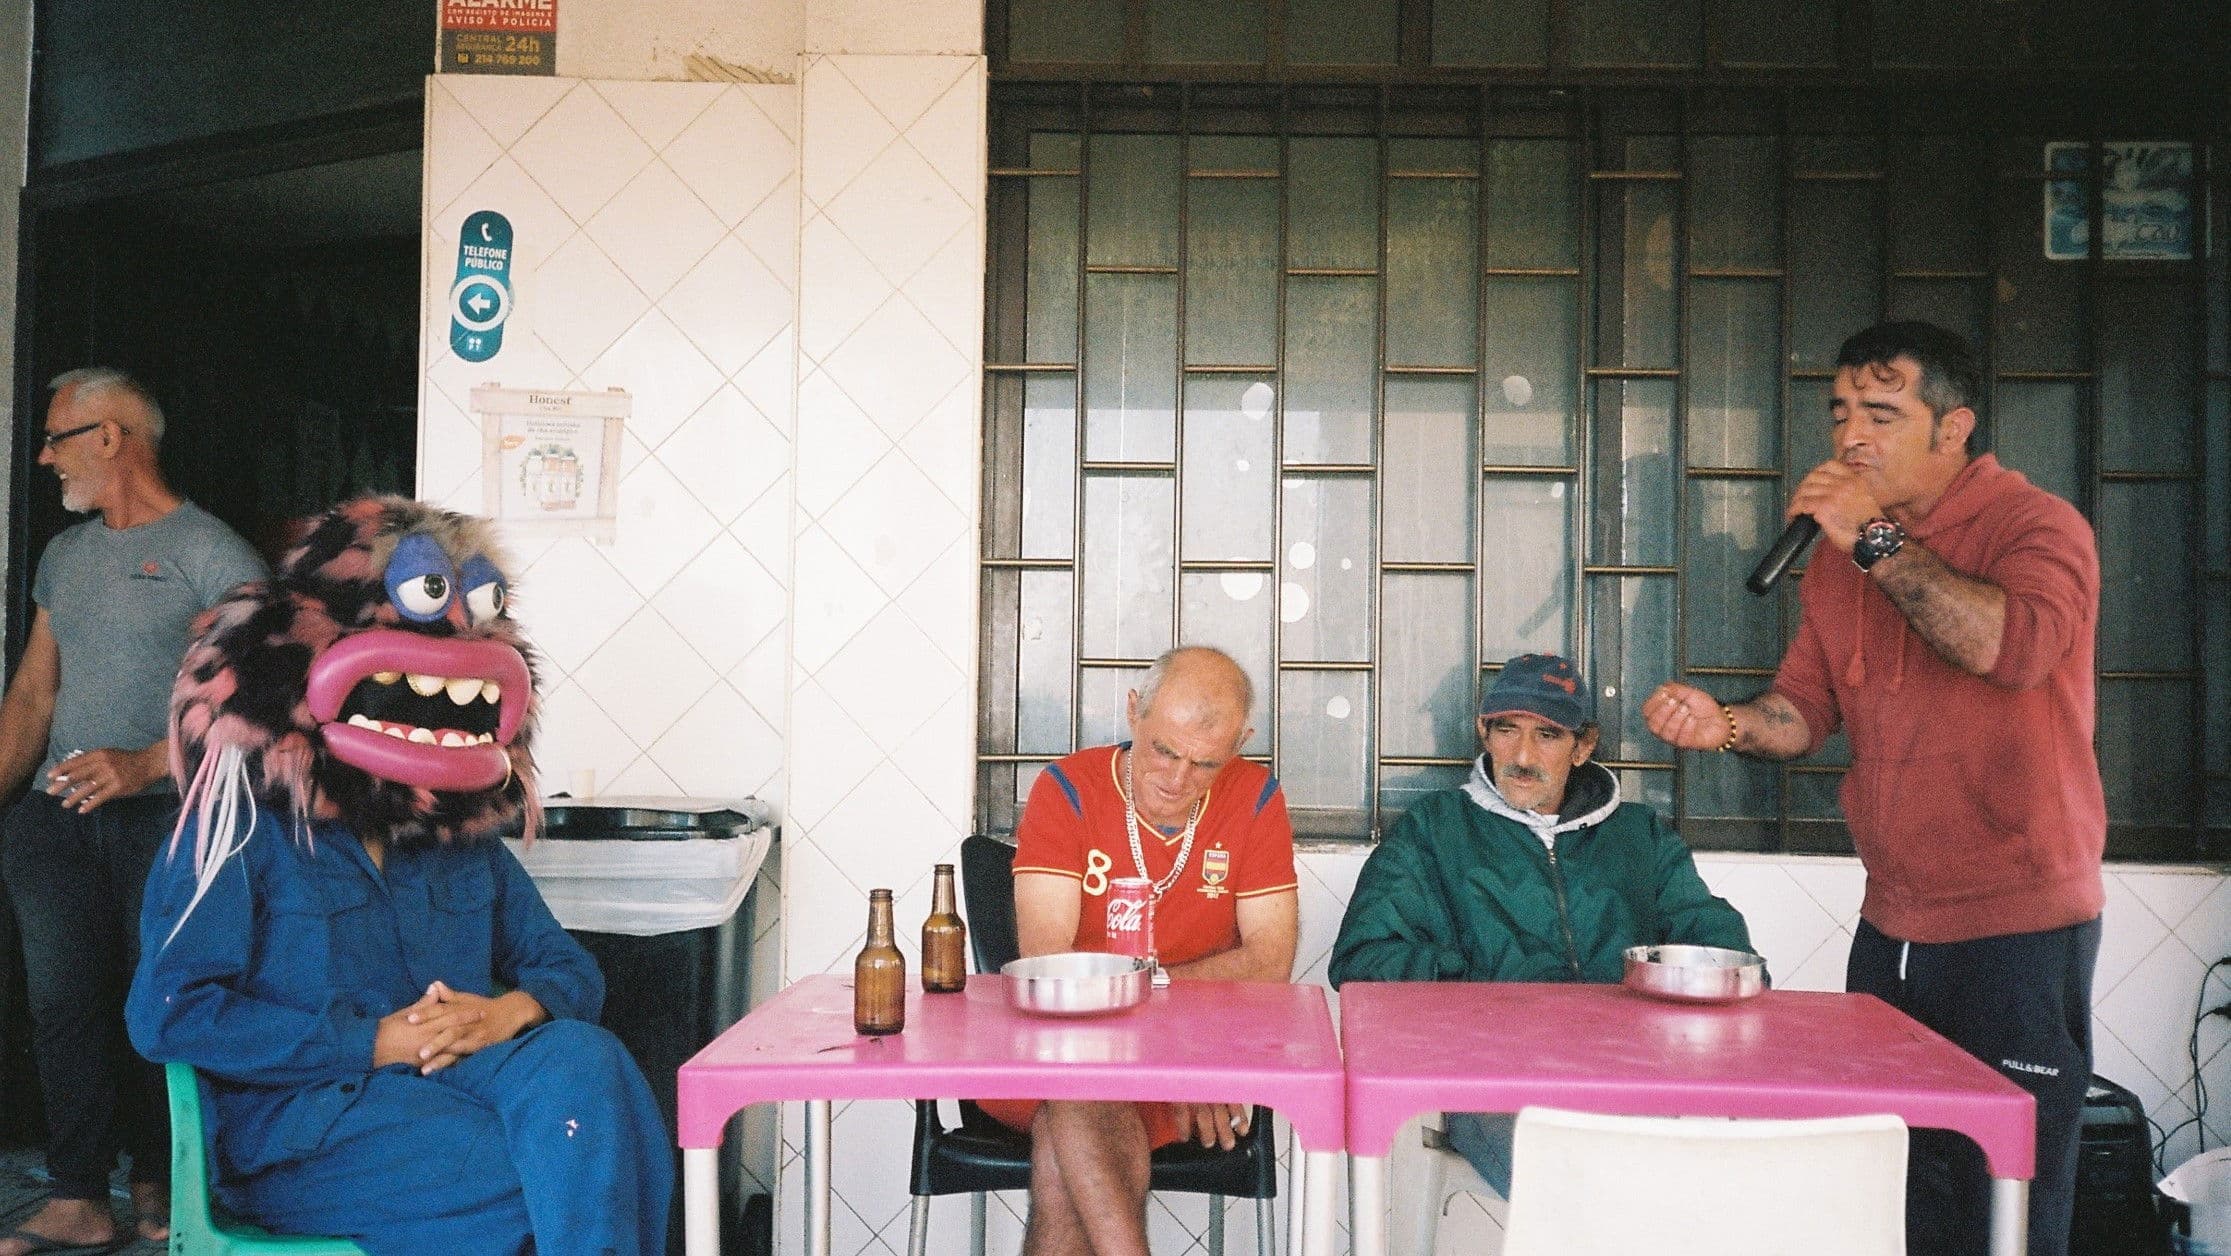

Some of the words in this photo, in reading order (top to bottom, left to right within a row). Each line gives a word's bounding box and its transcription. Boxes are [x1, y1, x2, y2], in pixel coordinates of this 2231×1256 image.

[447, 15, 484, 25] AVISO
[505, 35, 540, 52] 24h
[463, 245, 507, 260] TELEFONE
[464, 256, 504, 271] PÚBLICO
[529, 394, 571, 405] Honest
[1082, 849, 1112, 896] 8
